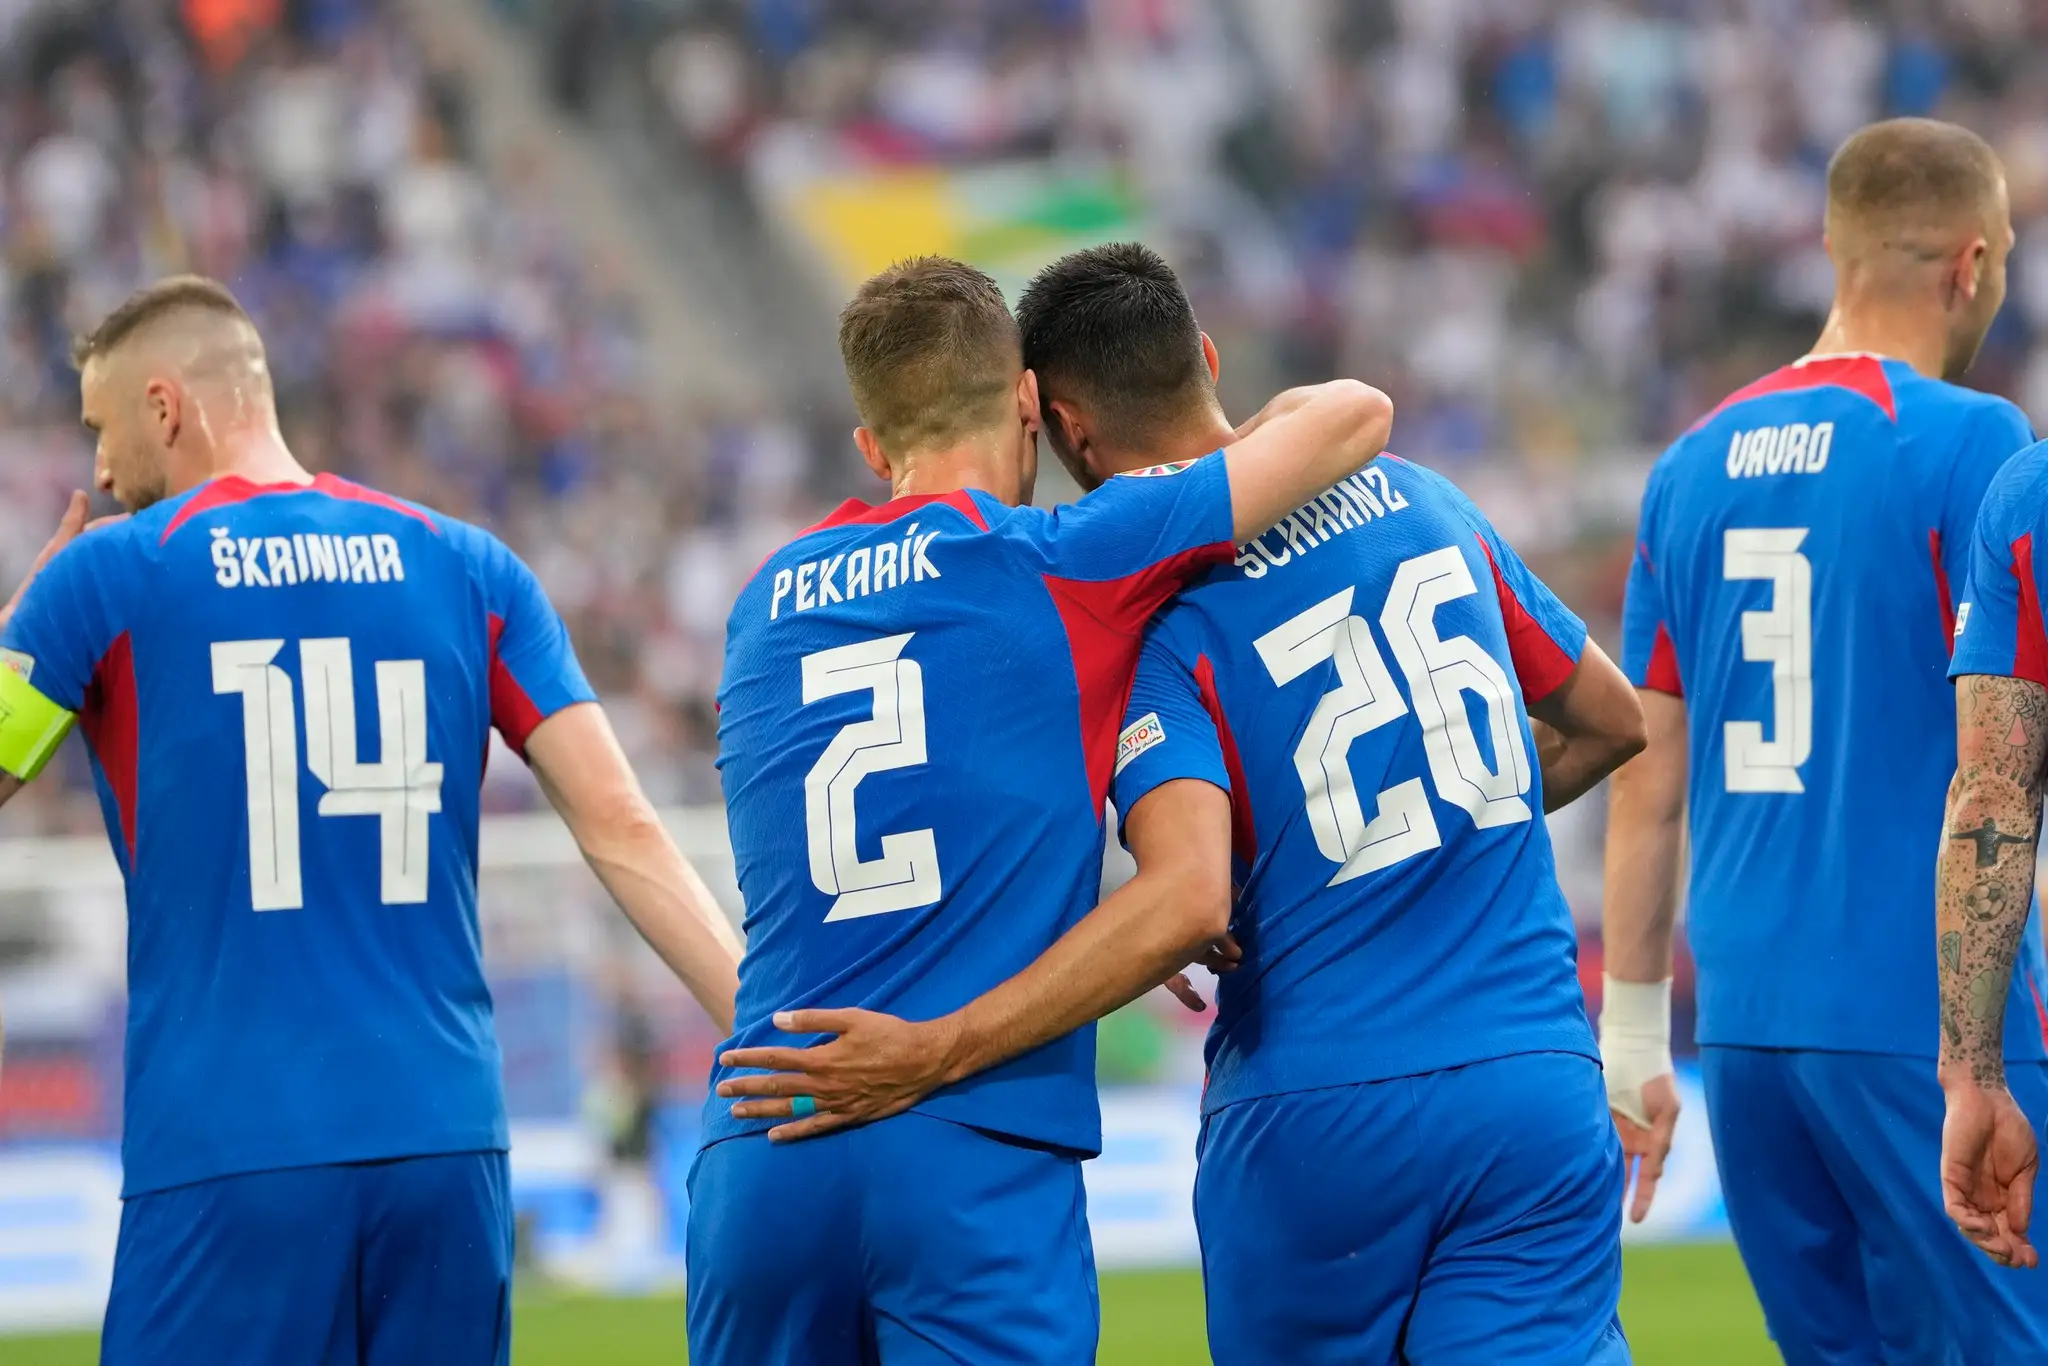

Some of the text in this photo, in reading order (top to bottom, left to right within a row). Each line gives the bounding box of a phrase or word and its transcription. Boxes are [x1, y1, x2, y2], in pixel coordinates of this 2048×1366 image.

[210, 527, 404, 588] ŠKRINIAR
[770, 523, 941, 620] PEKARÍK
[1725, 422, 1833, 478] VAVRO
[210, 637, 444, 911] 14
[801, 632, 941, 922] 2
[1252, 545, 1532, 888] 26
[1723, 528, 1812, 792] 3
